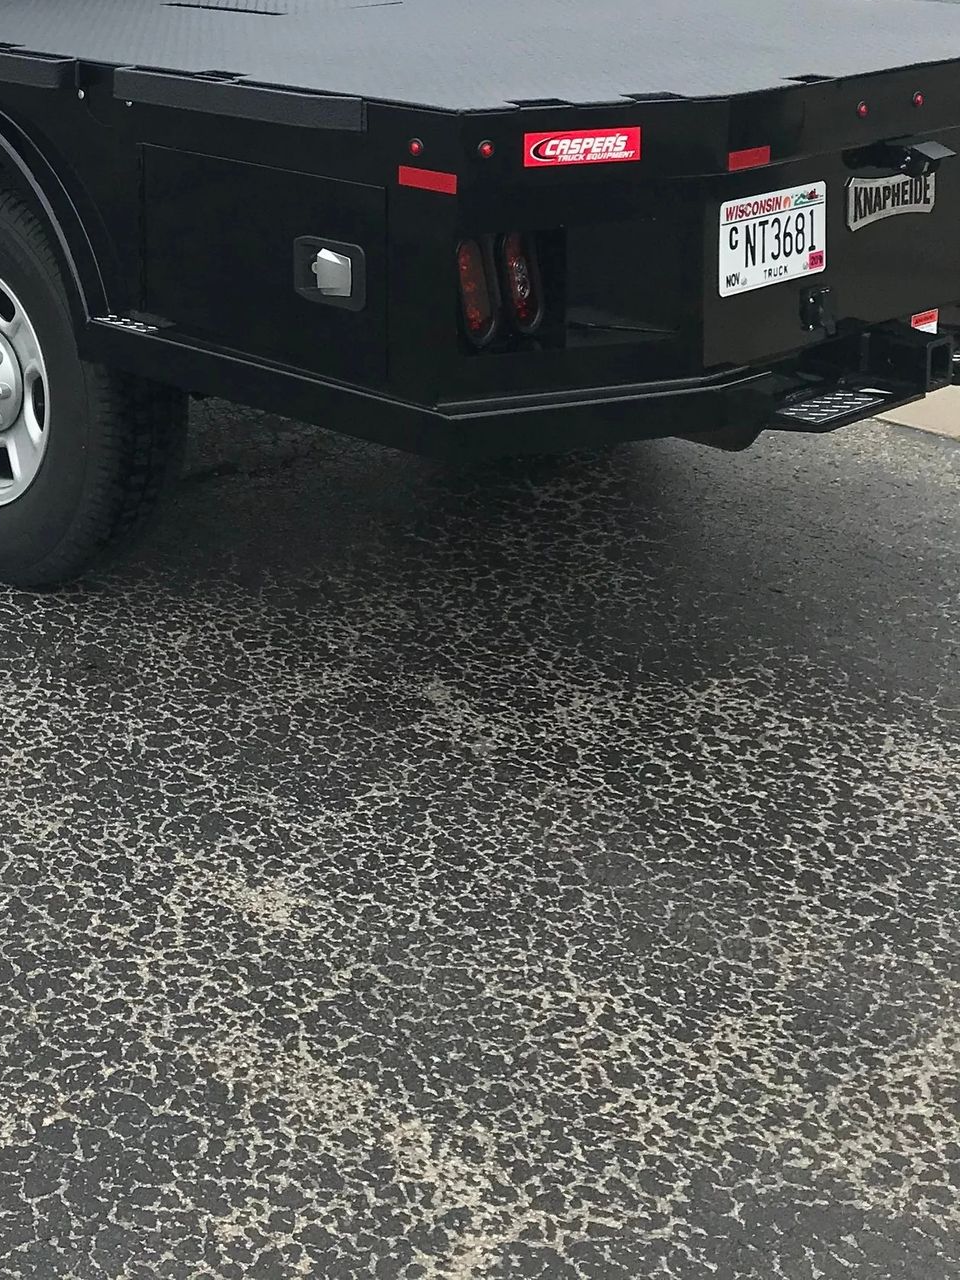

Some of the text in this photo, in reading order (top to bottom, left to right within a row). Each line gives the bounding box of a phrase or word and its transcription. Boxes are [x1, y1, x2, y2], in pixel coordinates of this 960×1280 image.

[544, 132, 628, 156] CASPER'S
[557, 150, 636, 163] TRUCK EQUIPMENT
[725, 195, 783, 222] WISCONSIN
[852, 176, 931, 224] KNAPHEIDE
[729, 209, 816, 268] C NT3681
[725, 271, 741, 288] NOV
[763, 265, 789, 280] TRUCK
